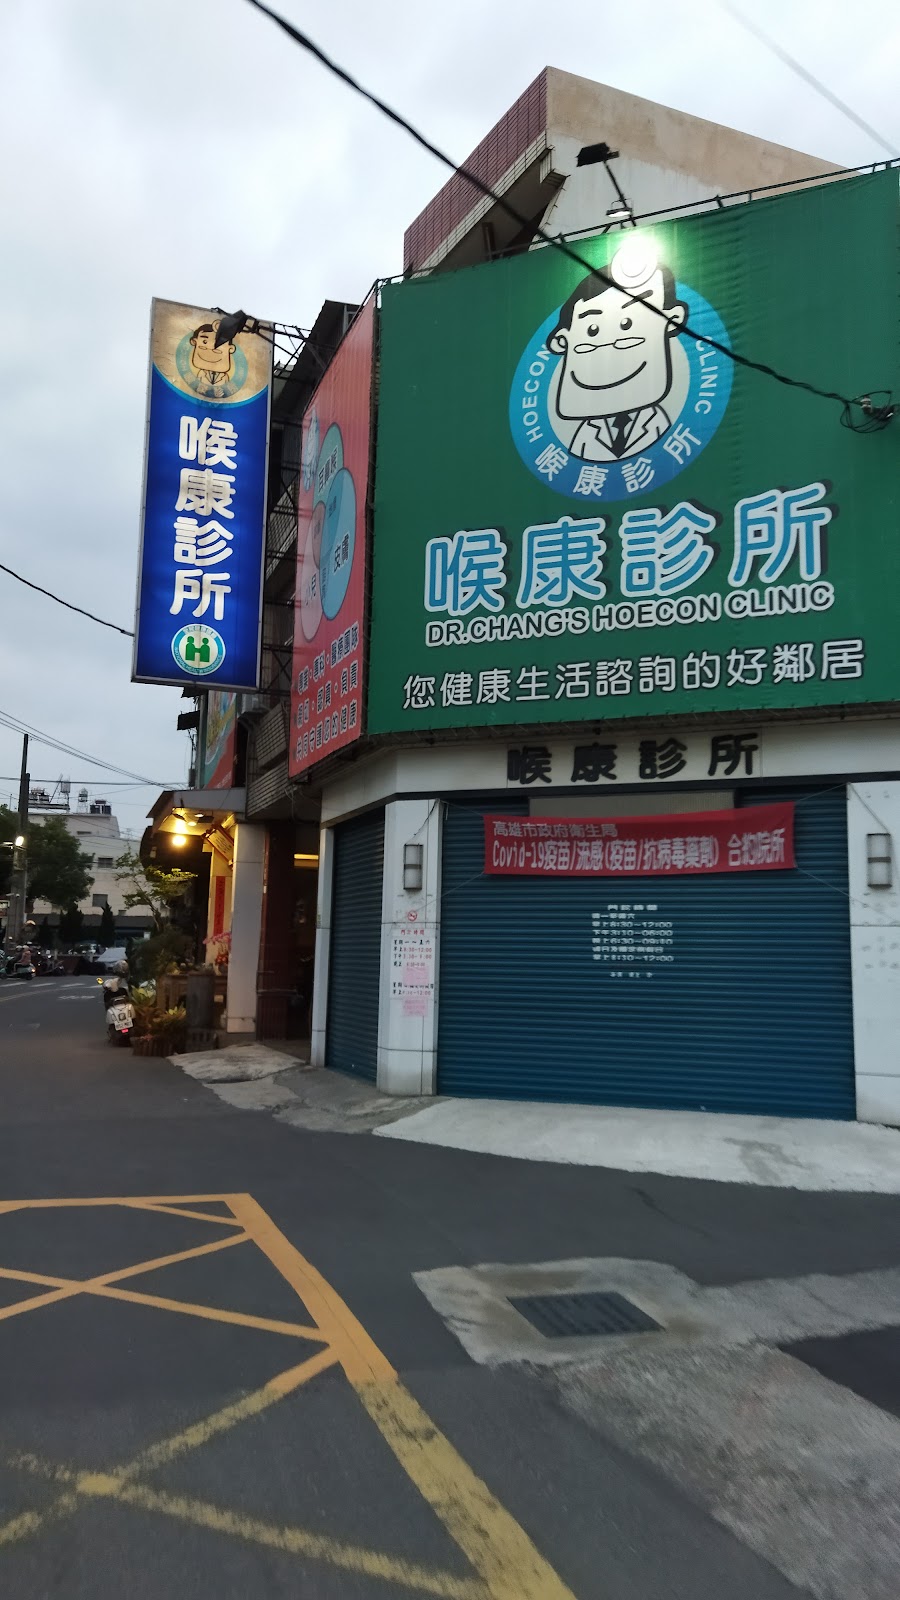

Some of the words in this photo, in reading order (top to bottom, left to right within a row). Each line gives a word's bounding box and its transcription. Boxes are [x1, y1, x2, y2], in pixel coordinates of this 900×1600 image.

[522, 344, 551, 443] HOECON
[695, 336, 719, 415] CLINIC
[535, 423, 702, 496] 喉康診所
[170, 415, 239, 621] 喉康診所
[424, 482, 832, 616] 喉康診所
[426, 607, 589, 647] DR.CHANG'S
[592, 592, 721, 632] HOECON
[724, 580, 834, 619] CLINIC
[402, 639, 865, 709] 您健康生活諮詢的好鄰居
[507, 732, 759, 784] 喉康診所
[493, 821, 618, 838] 高雄市政府衛生局
[727, 828, 786, 867] 合約院所
